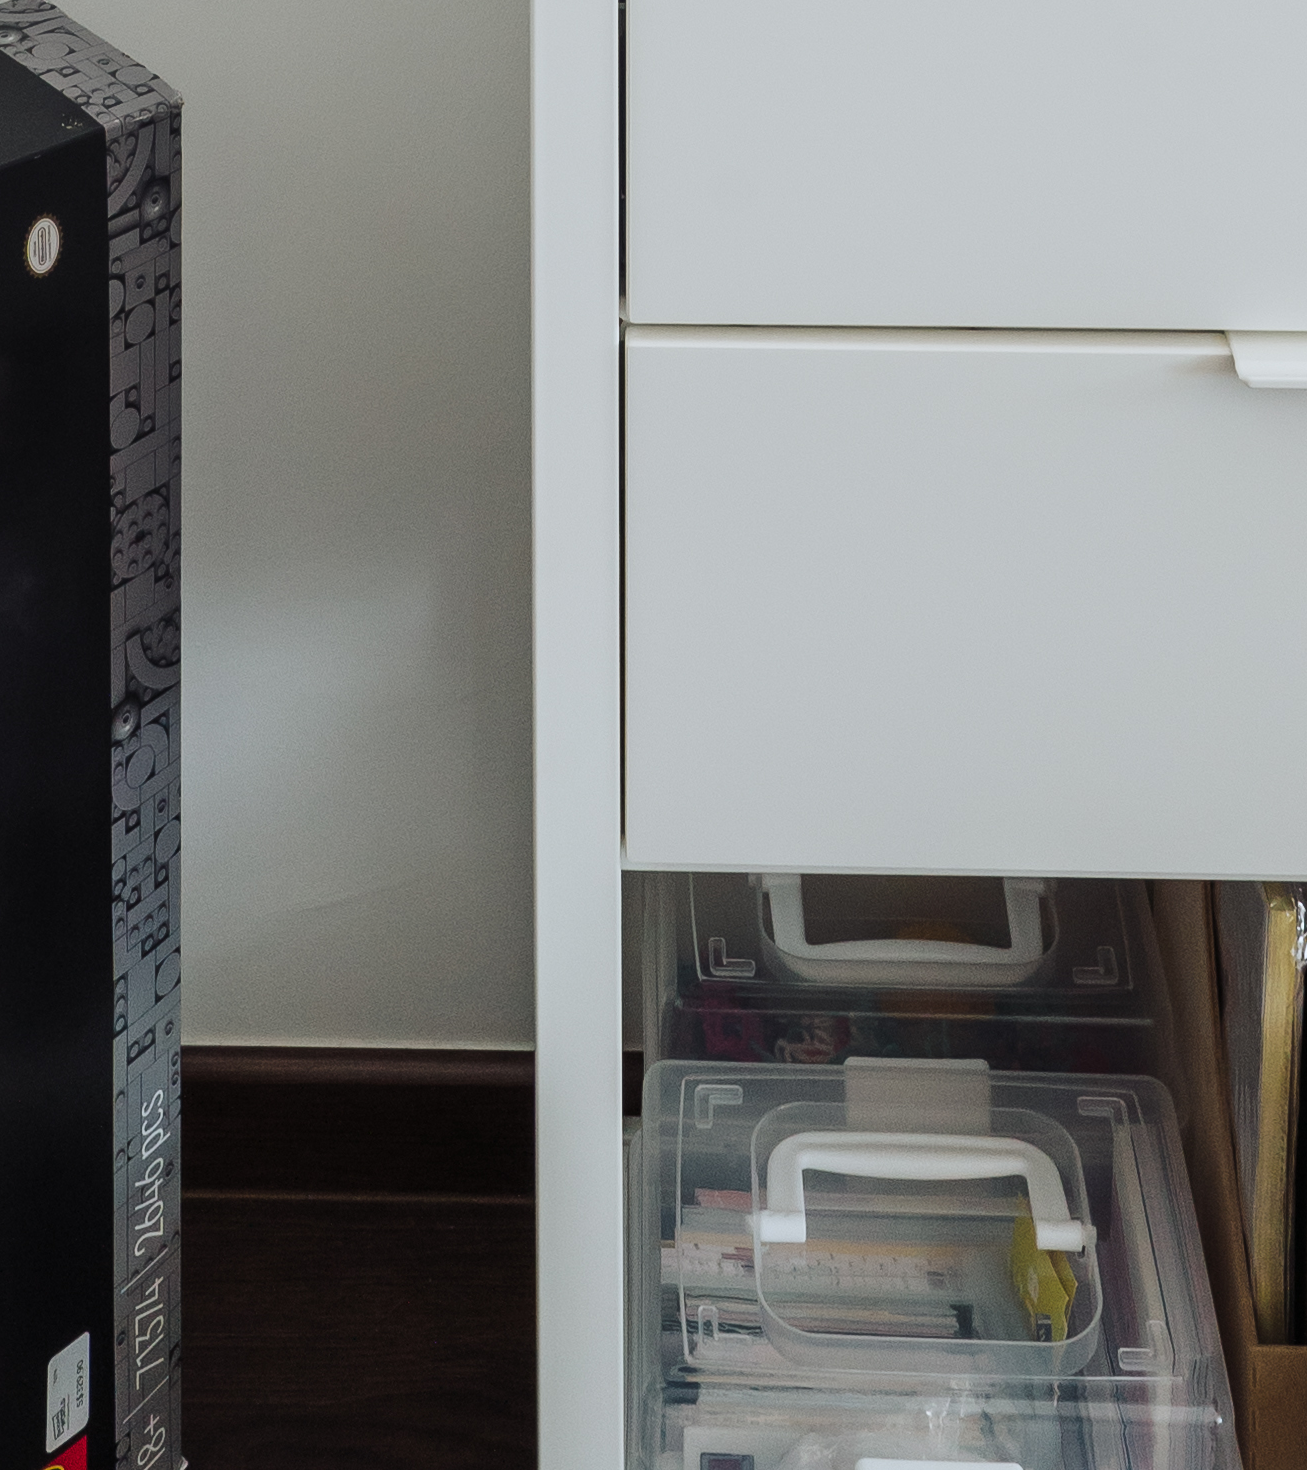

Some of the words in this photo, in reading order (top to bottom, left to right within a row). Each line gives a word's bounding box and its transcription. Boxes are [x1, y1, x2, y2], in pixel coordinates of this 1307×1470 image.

[141, 1088, 171, 1160] pcs
[134, 1156, 164, 1257] 2646
[134, 1275, 165, 1390] 71374
